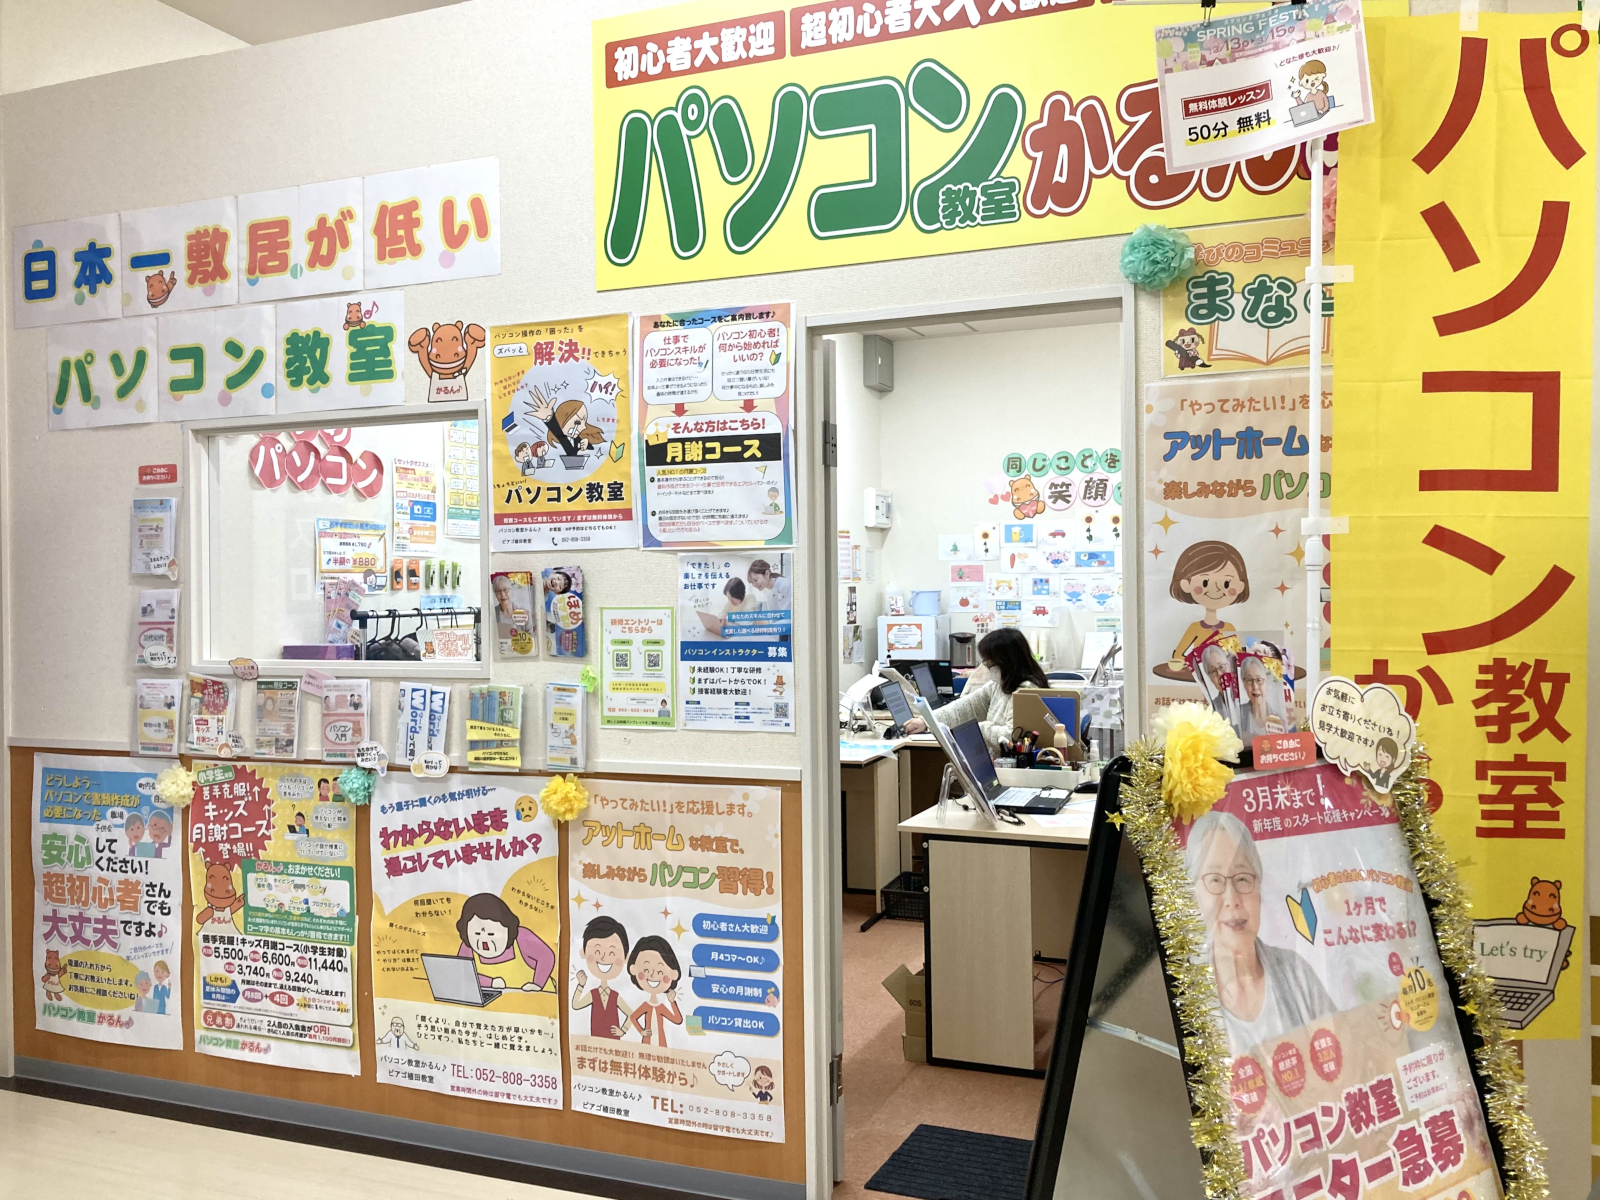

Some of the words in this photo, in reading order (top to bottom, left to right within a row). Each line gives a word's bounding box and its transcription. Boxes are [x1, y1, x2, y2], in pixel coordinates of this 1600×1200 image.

[1196, 22, 1256, 43] SPRING
[1258, 8, 1310, 31] FESTA
[613, 20, 776, 82] 初心者大歓迎
[1187, 89, 1267, 114] 無料体験レッスン
[1187, 121, 1229, 143] 50分
[1235, 109, 1272, 133] 無料
[22, 194, 491, 303] 日本一敷居が低い
[663, 334, 689, 346] 仕事で
[717, 327, 780, 341] パソコン初心者！
[645, 343, 706, 358] パソコンスキルが
[718, 338, 780, 353] 何から始めれば
[53, 322, 397, 408] パソコン教室
[733, 352, 764, 363] いいの？
[671, 418, 766, 434] そんな方はこちら！
[666, 439, 762, 463] 月謝コース
[1163, 425, 1309, 462] アットホーム
[255, 443, 378, 488] パソコン
[504, 480, 625, 505] パソコン教室
[1047, 477, 1110, 505] 笑顔
[683, 572, 730, 580] 楽しさを伝える
[683, 582, 717, 590] お仕事です
[684, 648, 764, 656] パソコンインストラクター
[767, 646, 788, 658] 募集
[329, 725, 351, 733] パソコン
[334, 733, 347, 741] 入門
[44, 790, 141, 808] パソコンで書類作成が
[204, 796, 252, 821] キッズ
[43, 805, 102, 821] 必要になった
[192, 820, 271, 842] 月謝コース
[378, 807, 509, 850] わからないまま
[582, 820, 685, 851] アットホーム
[41, 832, 93, 869] 安心
[383, 833, 543, 879] 過ごしていませんか？
[94, 856, 150, 875] ください！
[582, 862, 647, 883] 楽しみながら
[42, 871, 143, 914] 超初心者
[145, 882, 171, 899] さん
[144, 900, 172, 916] でも
[42, 908, 120, 950] 大丈夫
[702, 919, 769, 935] 初心者さん大歓迎
[1479, 941, 1518, 958] Let's
[1523, 944, 1548, 963] try
[711, 984, 763, 998] 安心の月謝制
[708, 1015, 765, 1030] パソコン貸出OK
